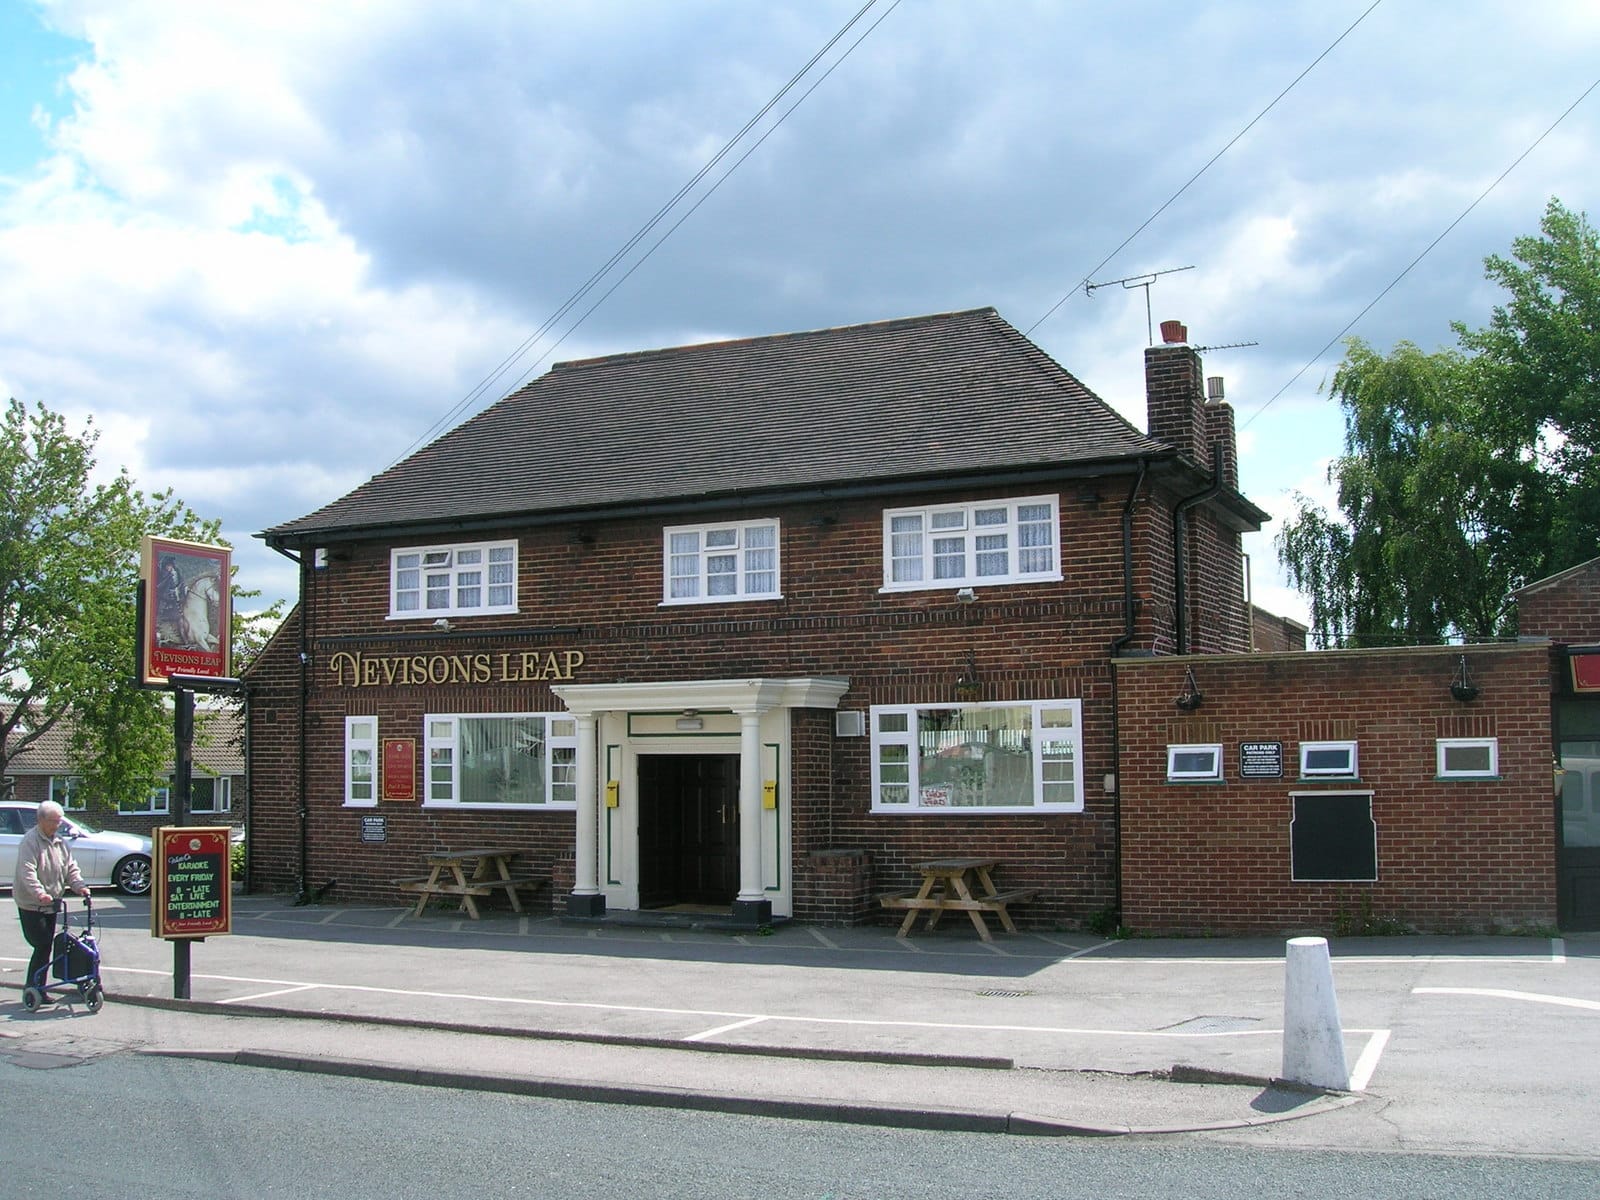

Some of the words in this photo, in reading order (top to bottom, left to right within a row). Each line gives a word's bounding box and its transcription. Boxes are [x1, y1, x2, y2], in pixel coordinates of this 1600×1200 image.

[154, 651, 200, 664] NEVISONS
[200, 657, 222, 666] LEAP
[330, 651, 491, 687] NEVISONS
[499, 650, 584, 682] LEAP
[178, 861, 209, 869] KARAOKE
[168, 874, 189, 882] EVERY
[190, 873, 214, 881] FRIDAY
[192, 885, 211, 893] LATE
[168, 900, 220, 911] ENTERTAINMENT
[193, 910, 211, 918] LATE
